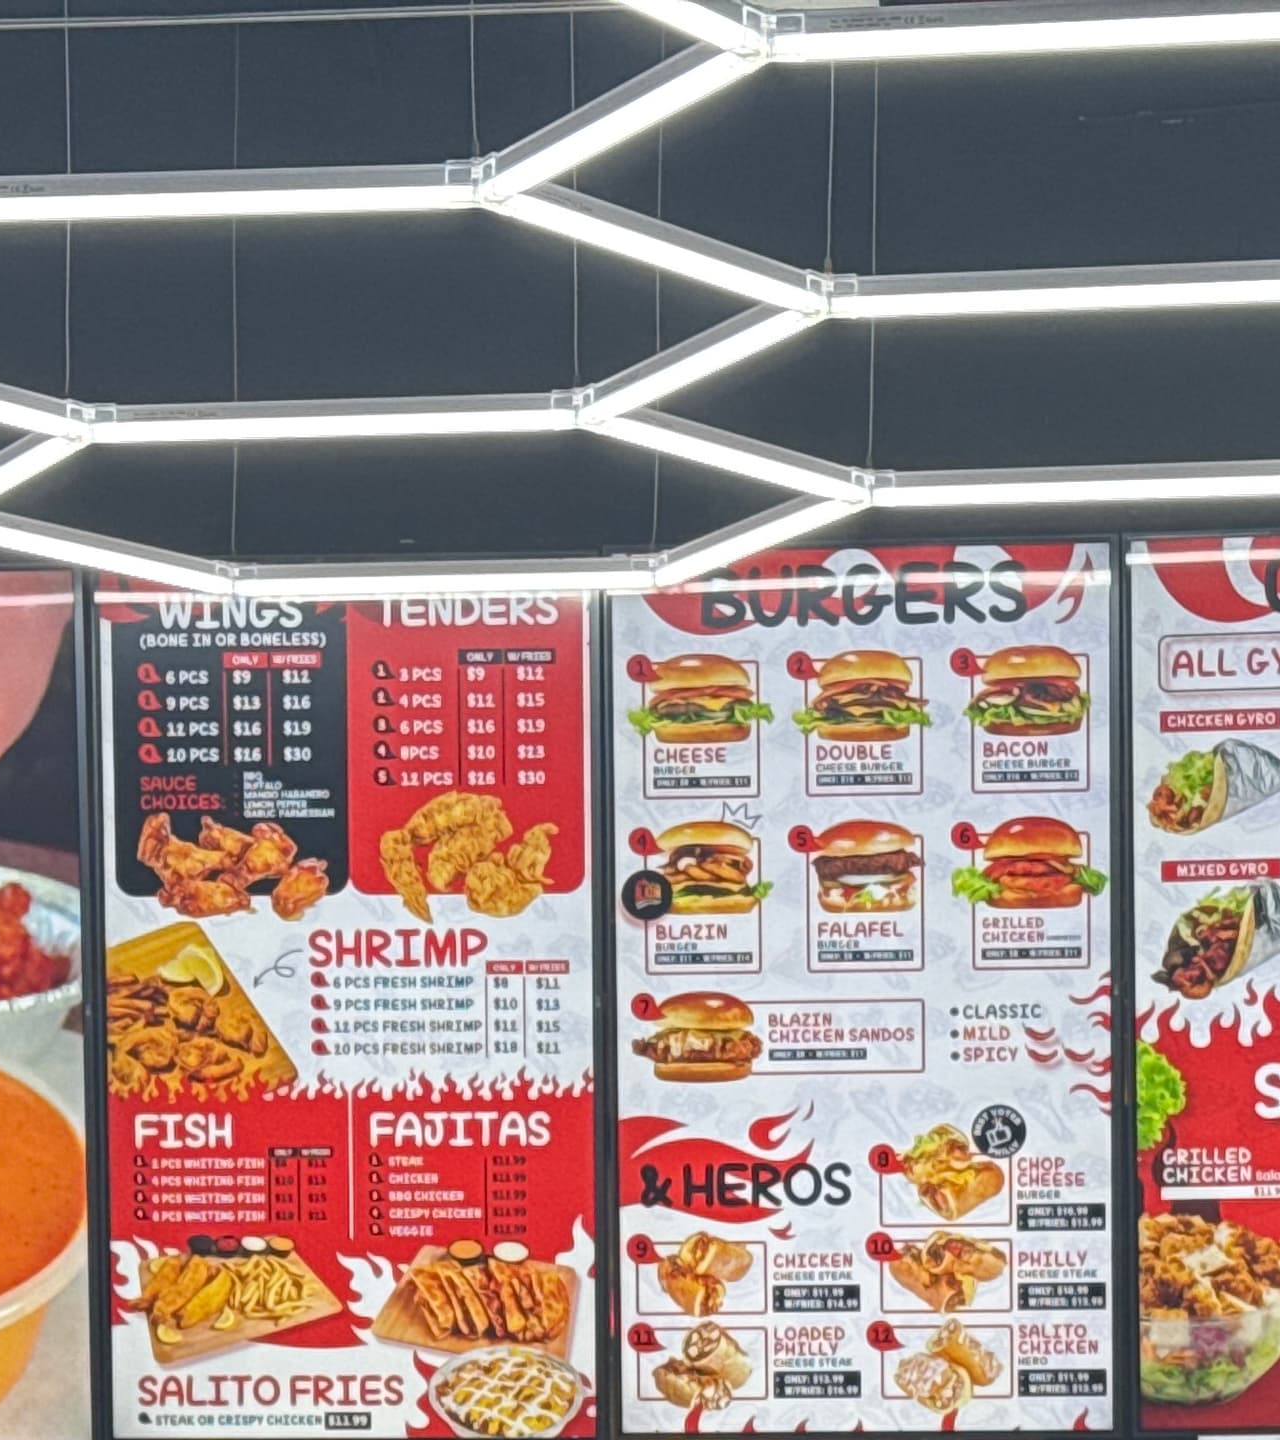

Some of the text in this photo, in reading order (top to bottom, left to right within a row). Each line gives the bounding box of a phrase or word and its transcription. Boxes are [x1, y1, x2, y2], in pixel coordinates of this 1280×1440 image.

[701, 560, 1028, 629] BURGERS
[158, 594, 303, 629] WINGS
[380, 592, 558, 627] TENDERS
[139, 632, 327, 649] (BONE IN OR BONELESS)
[1171, 646, 1238, 678] ALL
[1167, 710, 1277, 729] CHICKEN GYRO
[653, 747, 727, 764] CHEESE
[815, 743, 892, 761] DOUBLE
[983, 741, 1049, 758] BACON
[140, 775, 197, 792] SAUCE
[1176, 860, 1269, 878] MIXED GYRO
[817, 921, 904, 938] FALAFEL
[981, 916, 1045, 929] GRILLED
[655, 923, 728, 941] BLAZIN
[981, 930, 1046, 943] CHICKEN
[308, 928, 488, 968] SHRIMP
[332, 973, 475, 989] 6 PCS FRESH SHRIMP
[768, 1013, 833, 1027] BLAZIN
[962, 1004, 1042, 1019] CLASSIC
[768, 1028, 915, 1043] CHICKEN SANDOS
[962, 1026, 1010, 1041] MILD
[962, 1047, 1018, 1063] SPICY
[133, 1112, 234, 1149] FISH
[370, 1110, 551, 1148] FAJITAS
[1017, 1157, 1065, 1172] CHOP
[1162, 1147, 1252, 1165] GRILLED
[1017, 1172, 1086, 1187] CHEESE
[1162, 1166, 1253, 1184] CHICKEN
[640, 1162, 853, 1207] & HEROS
[773, 1253, 854, 1269] CHICKEN
[1018, 1251, 1087, 1268] PHILLY
[773, 1326, 845, 1341] LOADED
[1018, 1323, 1087, 1339] SALITO
[773, 1341, 839, 1356] PHILLY
[1018, 1339, 1099, 1355] CHICKEN
[138, 1374, 404, 1407] SALITO FRIES
[155, 1413, 195, 1427] STEAK
[198, 1413, 214, 1426] OR
[218, 1413, 264, 1427] CRISPY
[266, 1412, 322, 1426] CHICKEN
